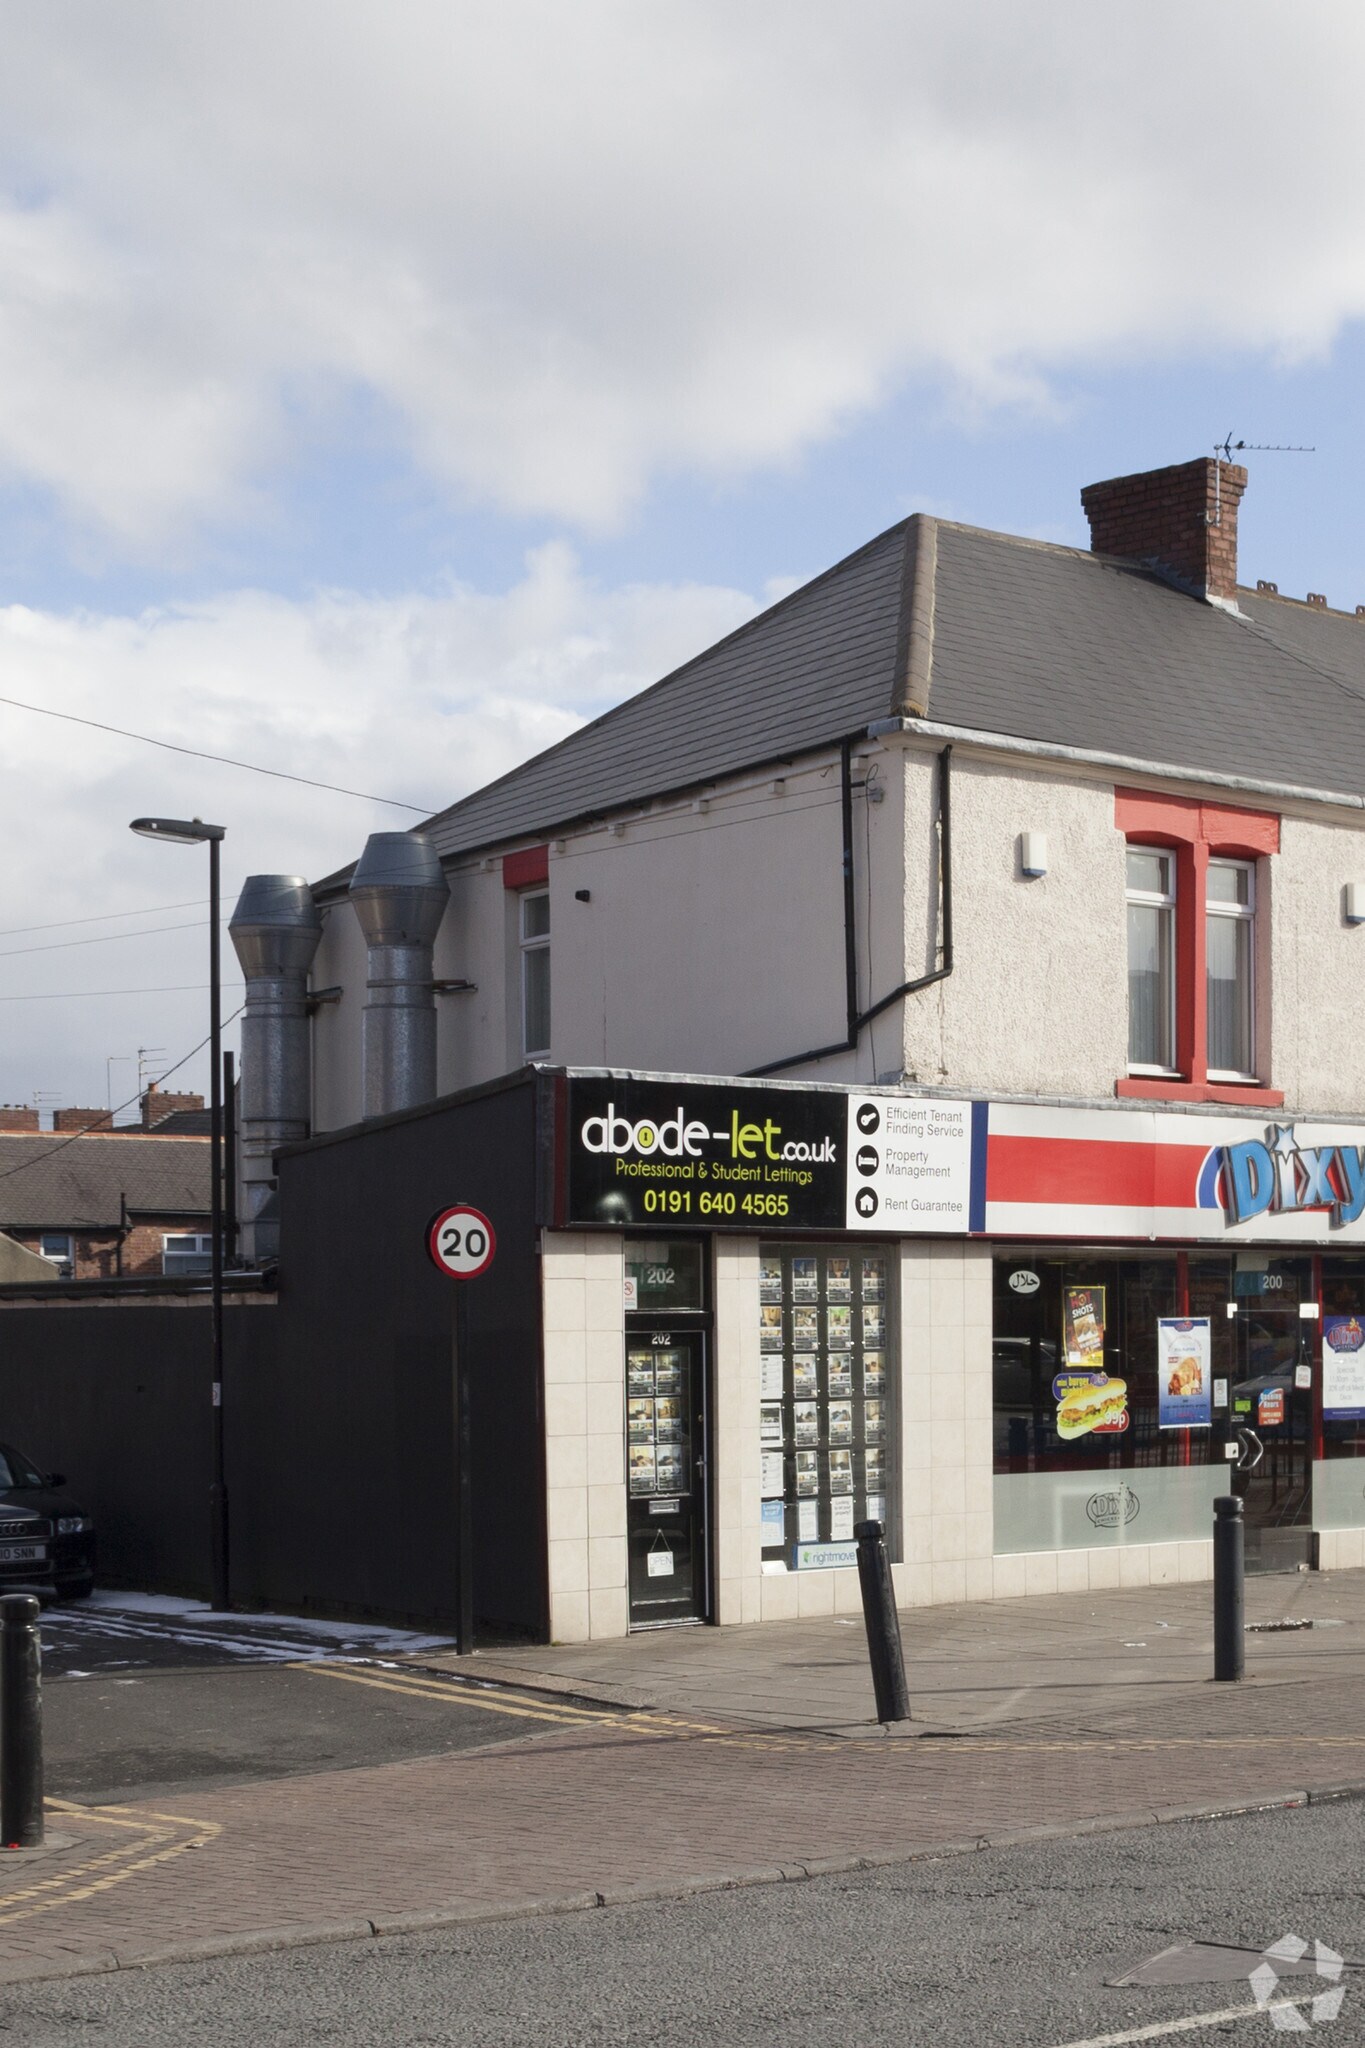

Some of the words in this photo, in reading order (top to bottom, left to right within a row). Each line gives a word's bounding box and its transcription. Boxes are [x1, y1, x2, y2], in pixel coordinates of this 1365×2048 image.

[886, 1107, 926, 1120] Efficient
[930, 1109, 962, 1123] Tenant
[581, 1103, 836, 1163] abode-let.co.uk
[886, 1122, 924, 1138] Finding
[927, 1123, 963, 1137] Service
[886, 1148, 928, 1163] Property
[616, 1158, 694, 1179] Professional
[698, 1164, 708, 1178] &
[712, 1163, 761, 1182] Student
[765, 1165, 812, 1185] Lettings
[886, 1163, 950, 1179] Management
[644, 1189, 691, 1213] 0191
[699, 1191, 736, 1214] 640
[742, 1193, 788, 1216] 4565
[885, 1197, 908, 1211] Rent
[911, 1198, 963, 1213] Guarantee
[442, 1228, 486, 1257] 20
[647, 1268, 675, 1284] 202
[1262, 1275, 1283, 1289] 200
[1072, 1303, 1094, 1318] SHOTS
[651, 1332, 671, 1345] 202
[13, 1547, 36, 1559] SNN
[812, 1549, 856, 1565] rightmove
